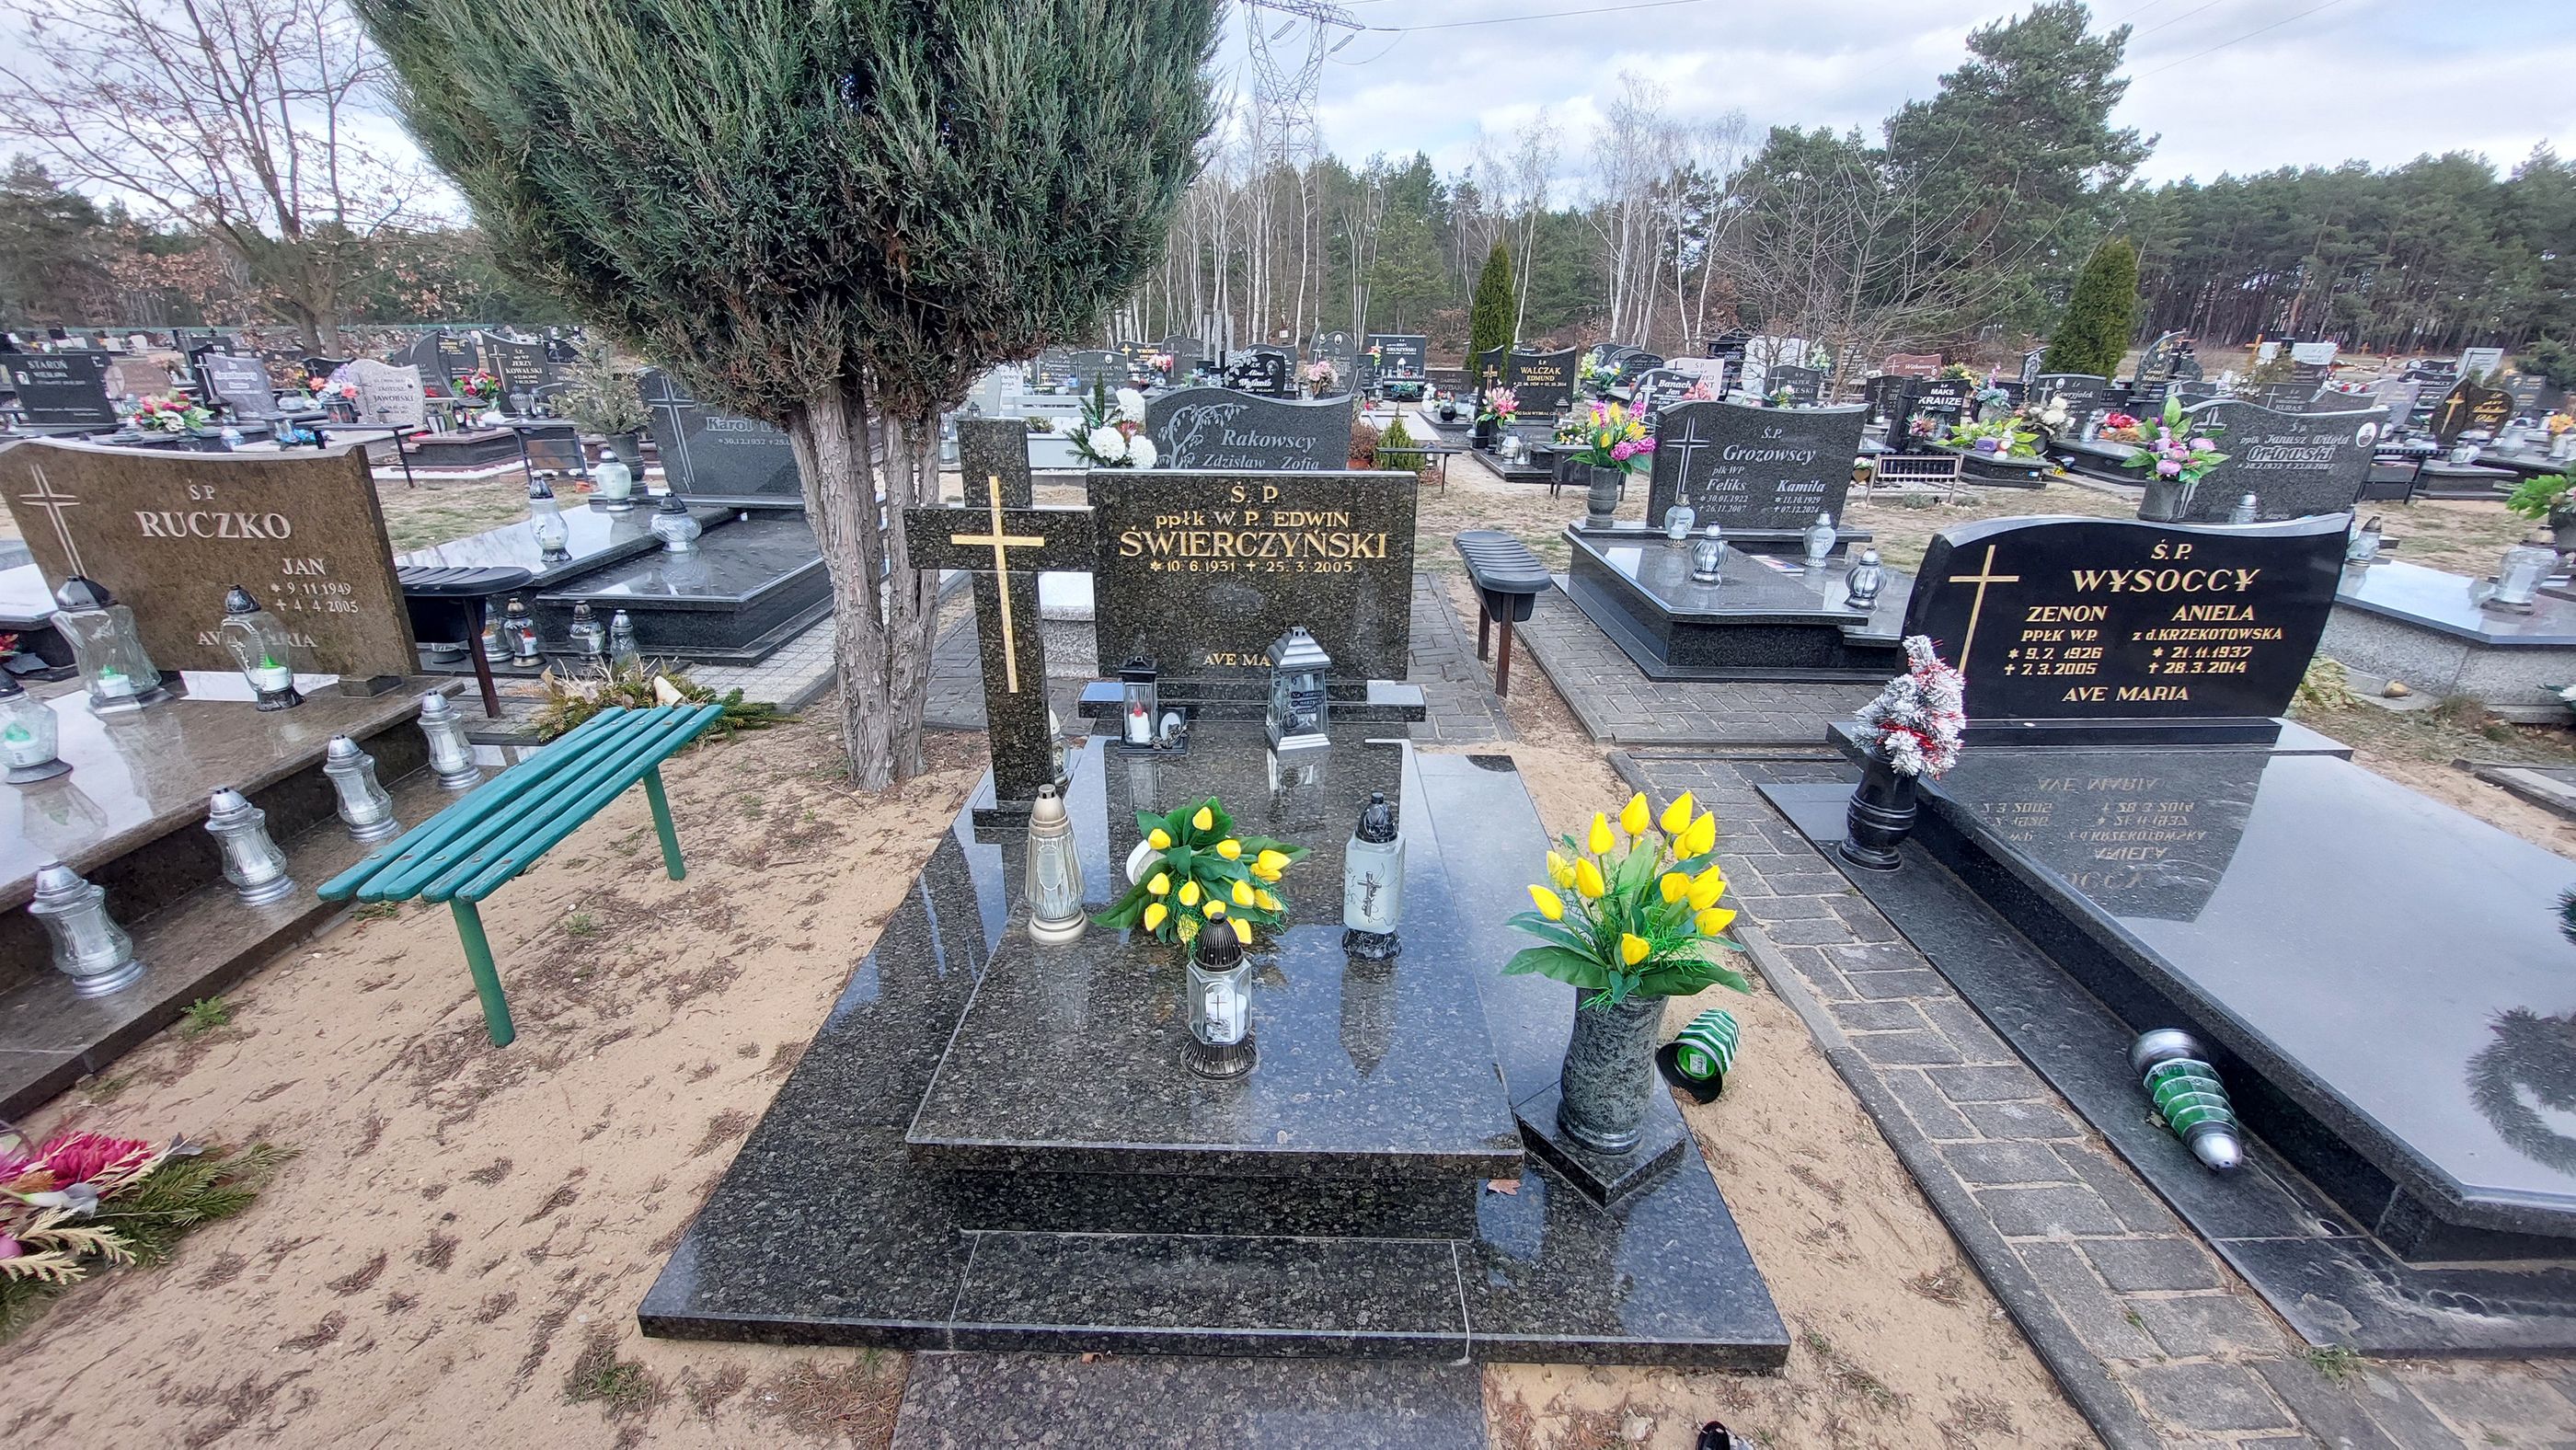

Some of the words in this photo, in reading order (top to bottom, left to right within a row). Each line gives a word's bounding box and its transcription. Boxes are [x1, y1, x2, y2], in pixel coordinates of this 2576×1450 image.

[1520, 366, 1562, 374] WALCZAK
[1658, 379, 1691, 388] Banach
[706, 417, 753, 432] Karol
[1221, 429, 1317, 451] Rakowscy
[2264, 433, 2308, 444] Janusz
[2312, 434, 2352, 444] Witold
[1723, 444, 1816, 466] Grozowscy
[2246, 444, 2337, 462] Orłowski
[1202, 454, 1267, 469] Zdzisław
[1281, 456, 1320, 470] Zofia
[1730, 466, 1745, 475] WP
[1707, 478, 1747, 490] Feliks
[1776, 479, 1825, 492] Kamila
[134, 511, 292, 539] RUCZKO
[1155, 511, 1206, 530] ppłk
[1273, 512, 1351, 528] EDWIN
[1120, 525, 1387, 558] ŚWIERCZYŃSKI
[282, 558, 327, 576] JAN
[2071, 569, 2261, 593] WYSOCCY
[2026, 605, 2108, 622] ZENON
[2171, 604, 2255, 621] ANIELA
[2020, 629, 2065, 641] PPŁK
[1202, 652, 1236, 667] AVE
[2062, 686, 2109, 701] AVE
[2115, 686, 2190, 701] MARIA
